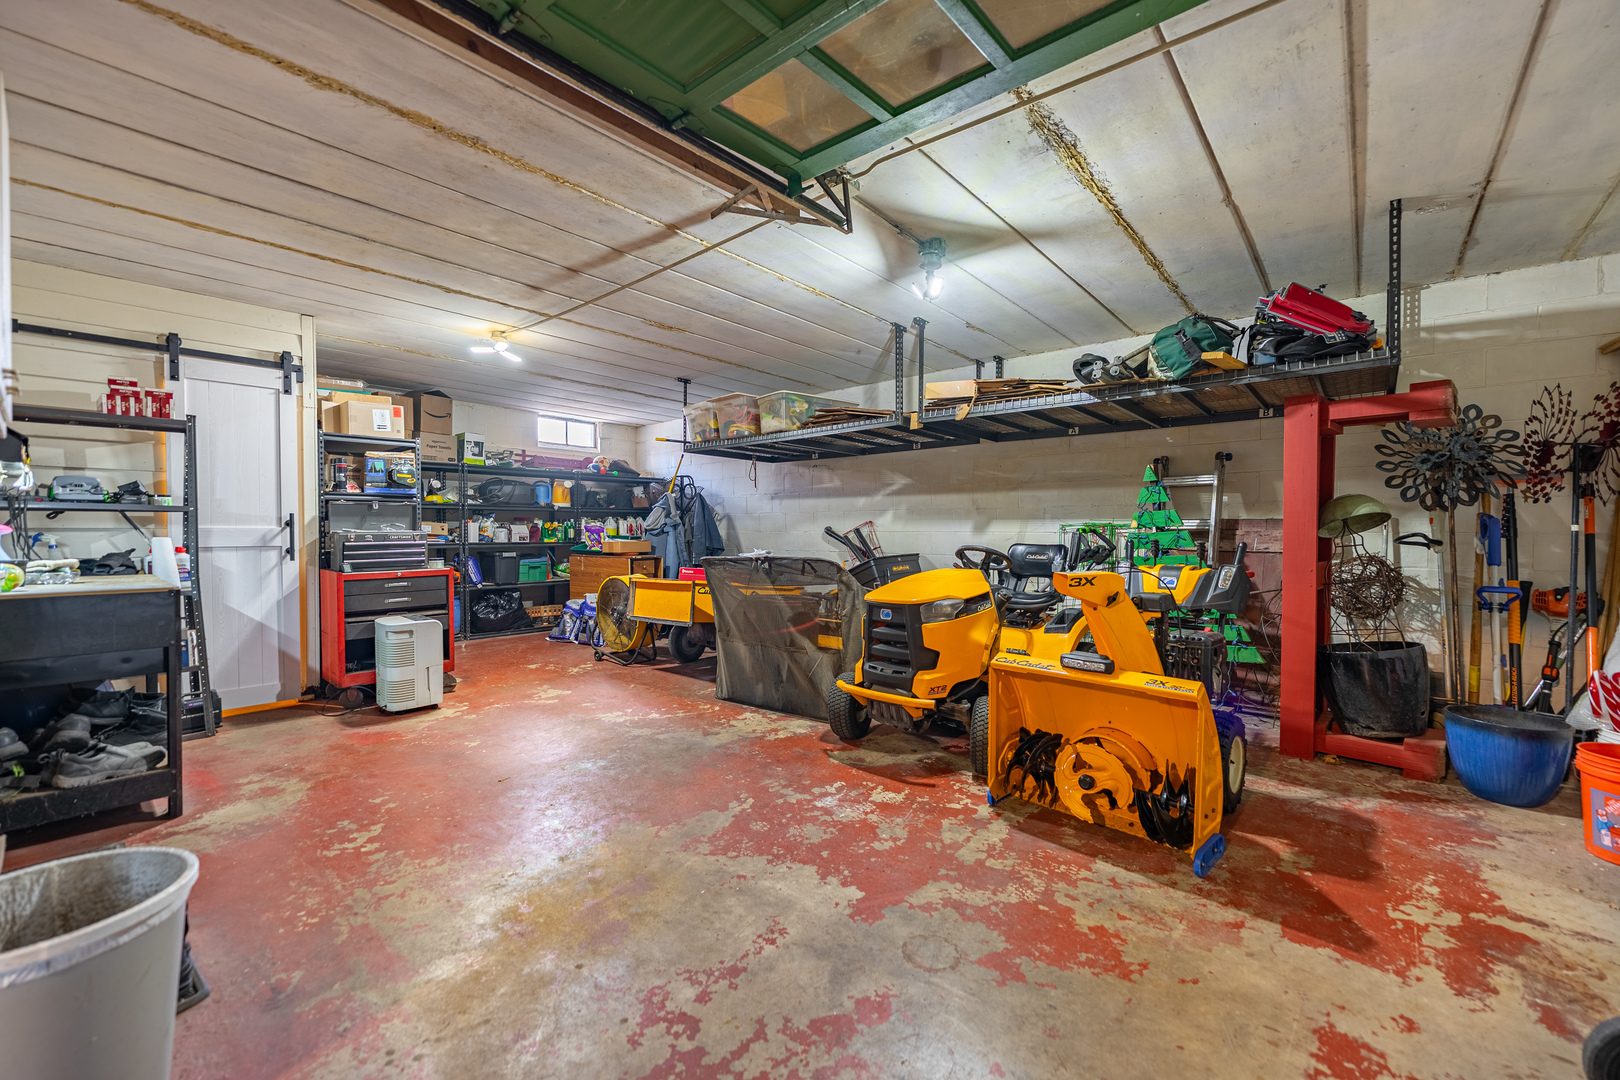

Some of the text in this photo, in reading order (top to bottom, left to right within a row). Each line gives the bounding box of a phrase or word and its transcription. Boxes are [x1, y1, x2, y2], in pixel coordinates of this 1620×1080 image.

[1263, 409, 1270, 417] B
[1068, 576, 1097, 588] 3X
[995, 656, 1056, 671] Cub Cadet
[1145, 678, 1170, 687] 3X
